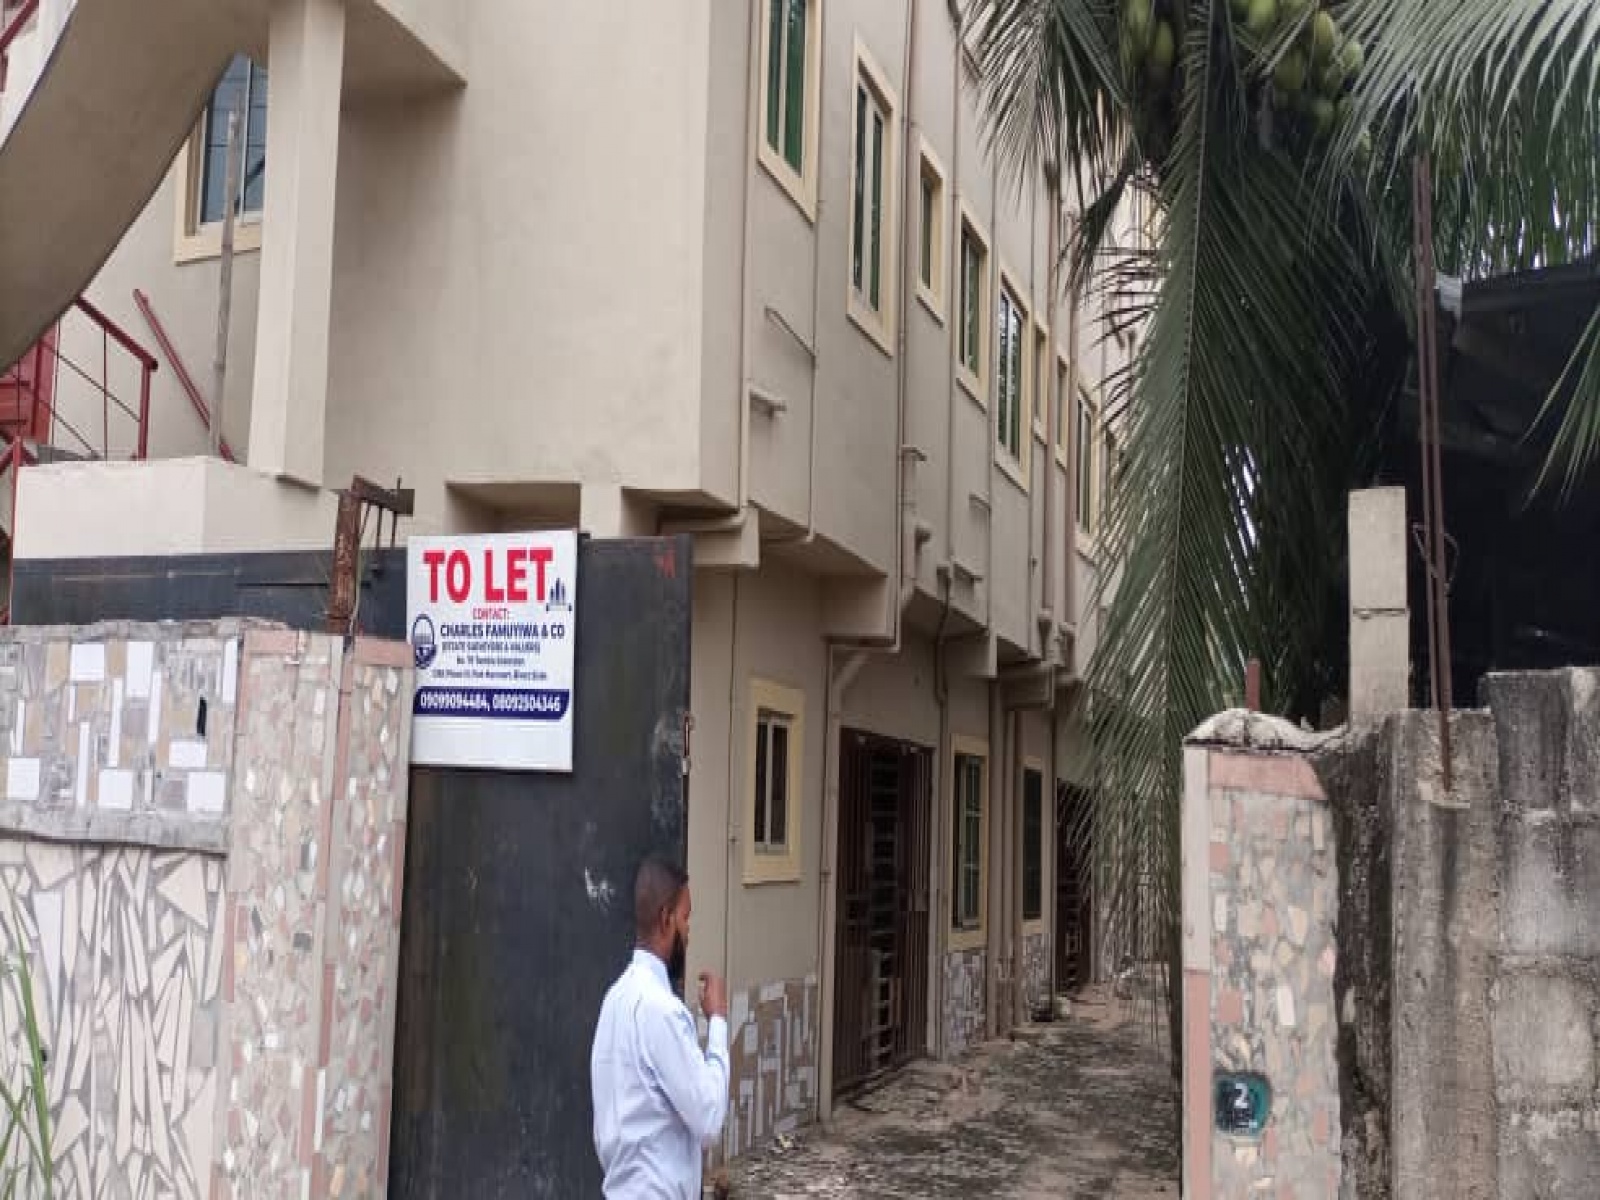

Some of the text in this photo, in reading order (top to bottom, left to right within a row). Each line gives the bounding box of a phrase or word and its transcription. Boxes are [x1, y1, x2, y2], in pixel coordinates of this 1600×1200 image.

[423, 549, 554, 604] TO LET
[472, 608, 511, 621] CONTACT:
[440, 623, 484, 640] CHARLES
[485, 623, 539, 640] FAMUYIWA
[551, 624, 565, 640] CO
